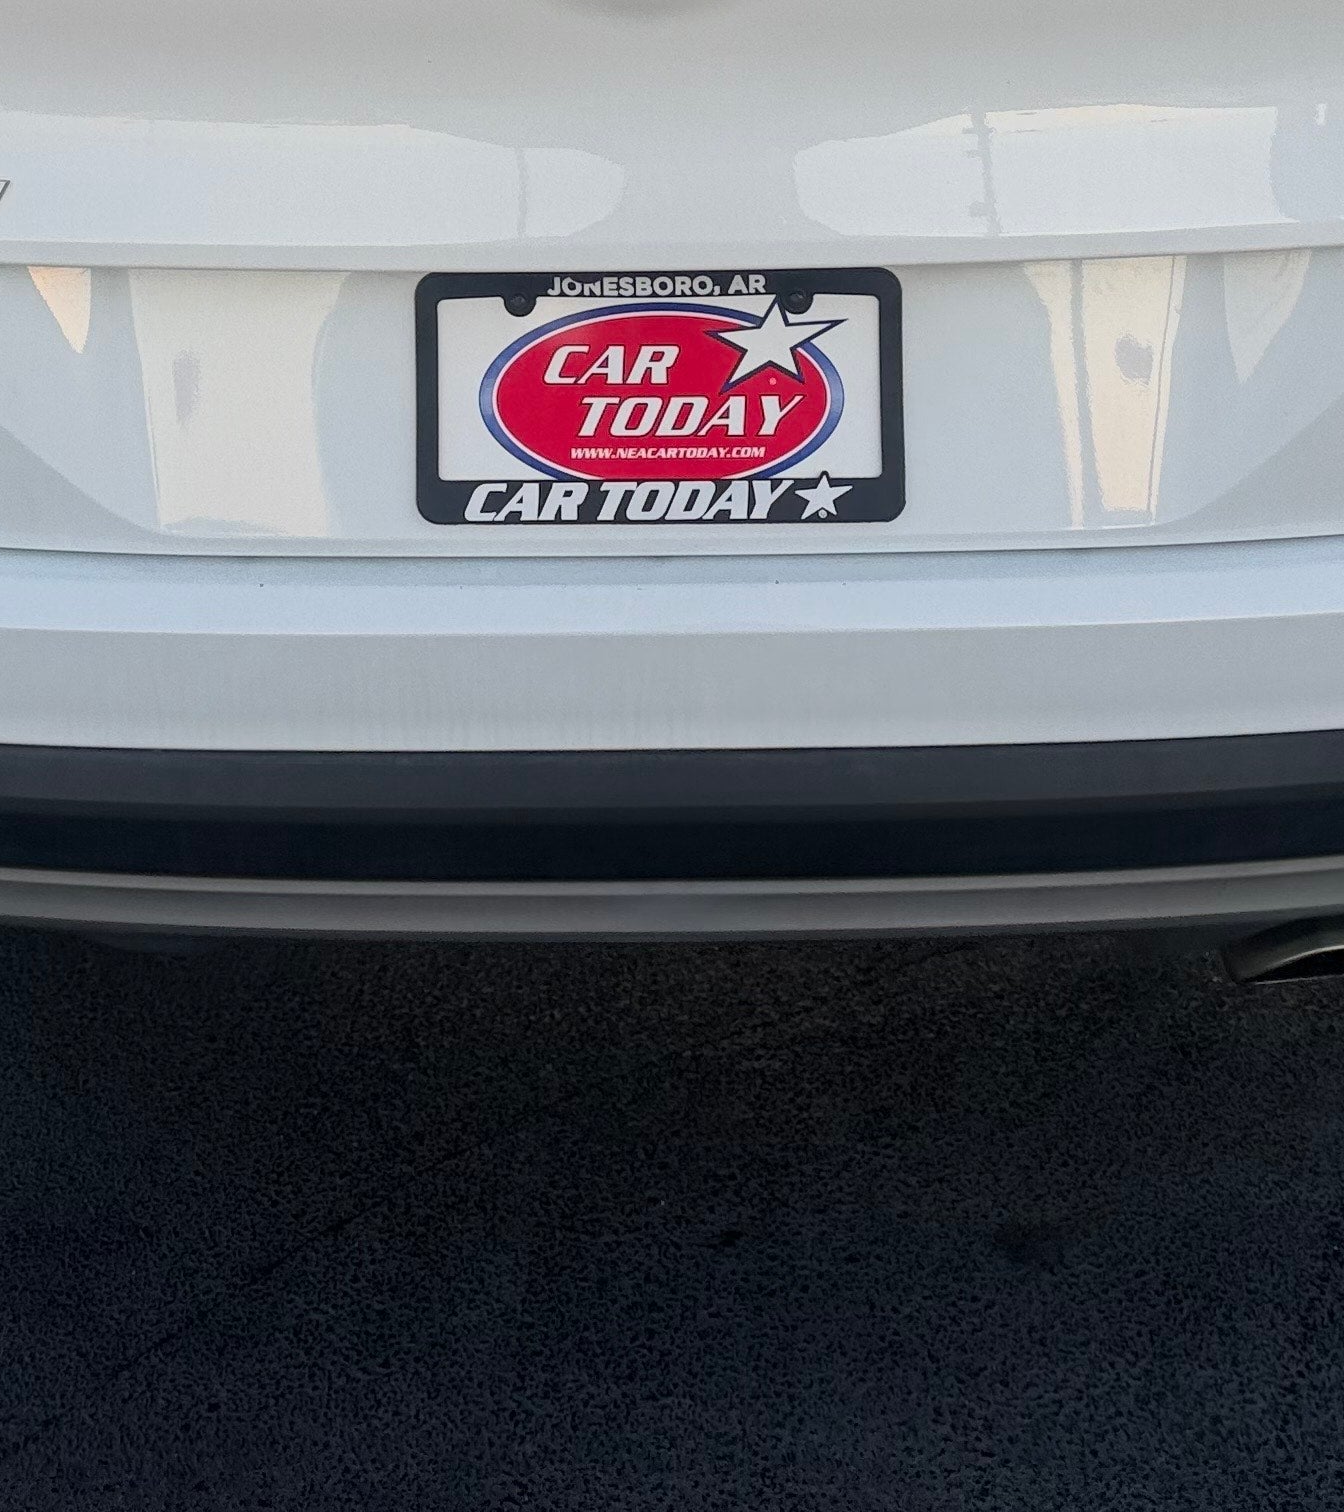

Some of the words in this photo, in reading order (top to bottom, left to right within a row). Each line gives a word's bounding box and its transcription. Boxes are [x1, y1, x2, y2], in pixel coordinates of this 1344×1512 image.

[547, 276, 721, 298] JONESBORO,
[730, 274, 766, 296] AR
[543, 345, 680, 385] CAR
[576, 394, 804, 438] TODAY
[570, 446, 766, 460] WWW.NEACARTODAY.COM
[463, 483, 590, 523] CAR
[595, 479, 794, 522] TODAY
